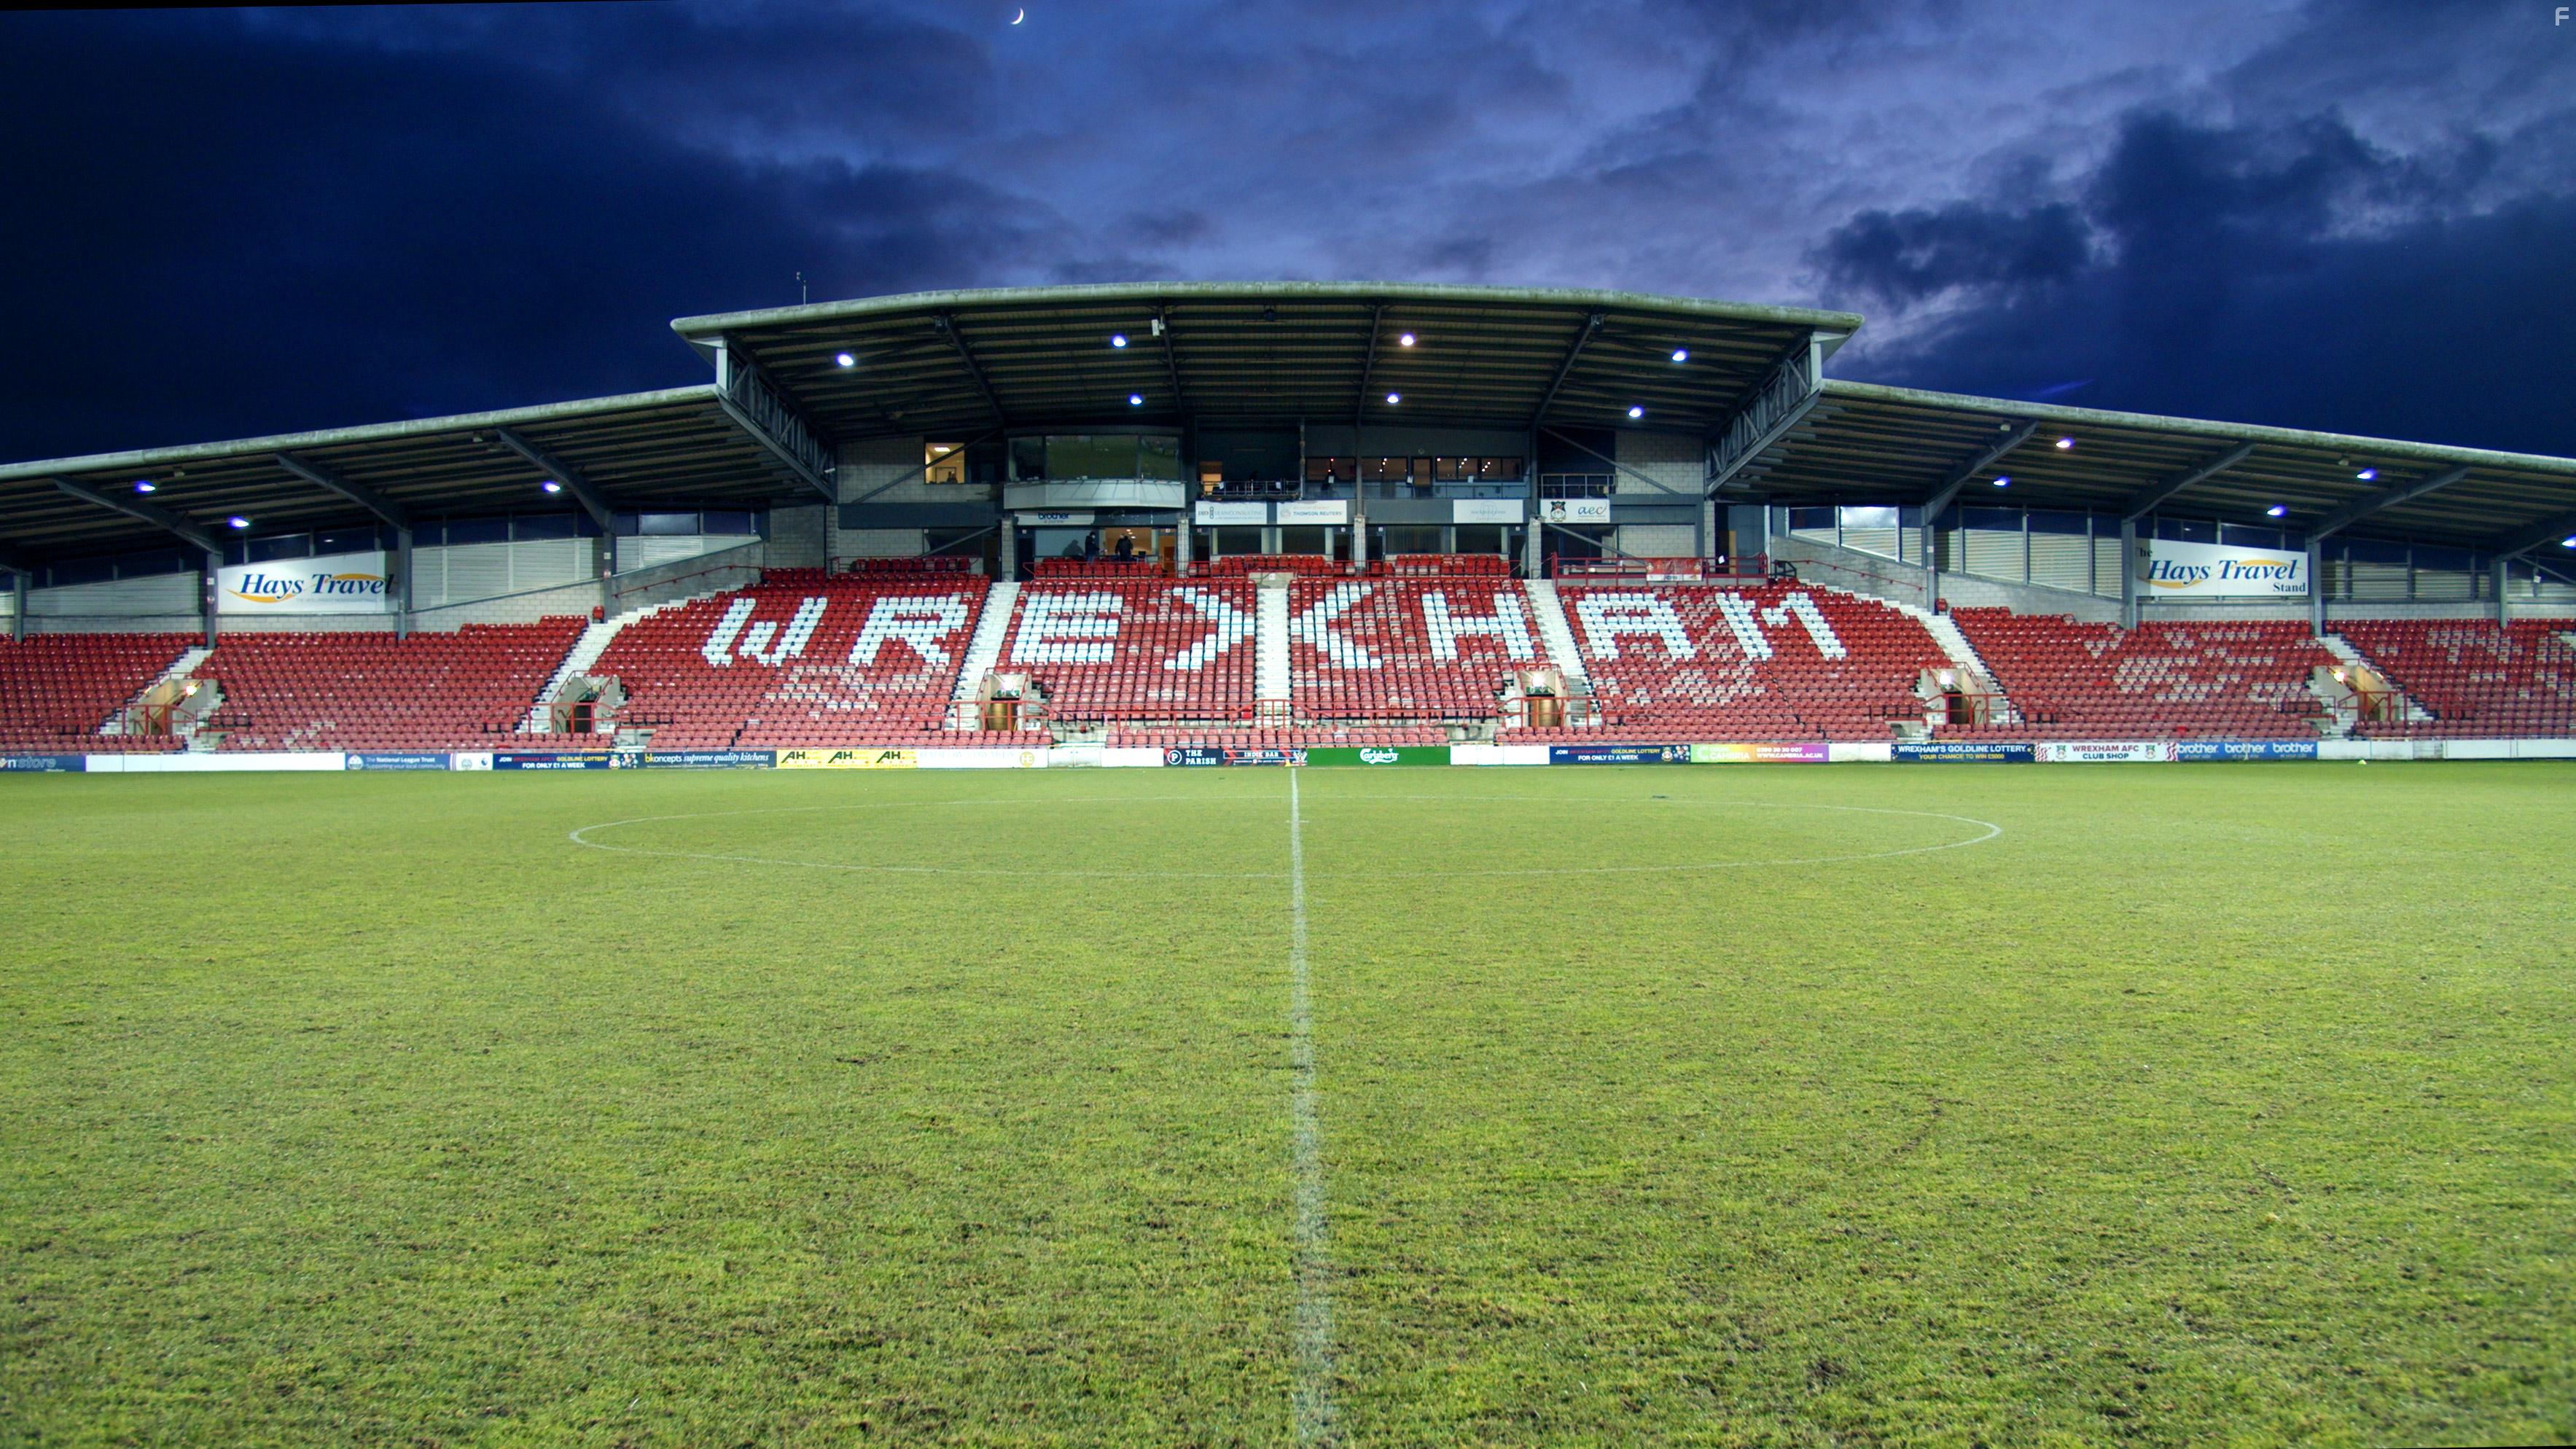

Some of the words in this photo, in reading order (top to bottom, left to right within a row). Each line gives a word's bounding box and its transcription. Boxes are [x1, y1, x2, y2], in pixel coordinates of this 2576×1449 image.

[2147, 560, 2211, 585] Hays
[2218, 560, 2298, 580] Travel
[239, 574, 304, 599] Hays
[311, 574, 395, 595] Travel
[2273, 582, 2306, 593] Stand
[2177, 743, 2218, 754] brother
[2225, 743, 2265, 754] brother
[2272, 742, 2314, 753] brother
[683, 753, 713, 763] supreme
[714, 752, 739, 763] quality
[740, 752, 769, 762] kitchens
[781, 751, 805, 763] AH
[828, 751, 852, 763] AH
[877, 751, 900, 763] AH
[1359, 748, 1399, 765] Carlsberg
